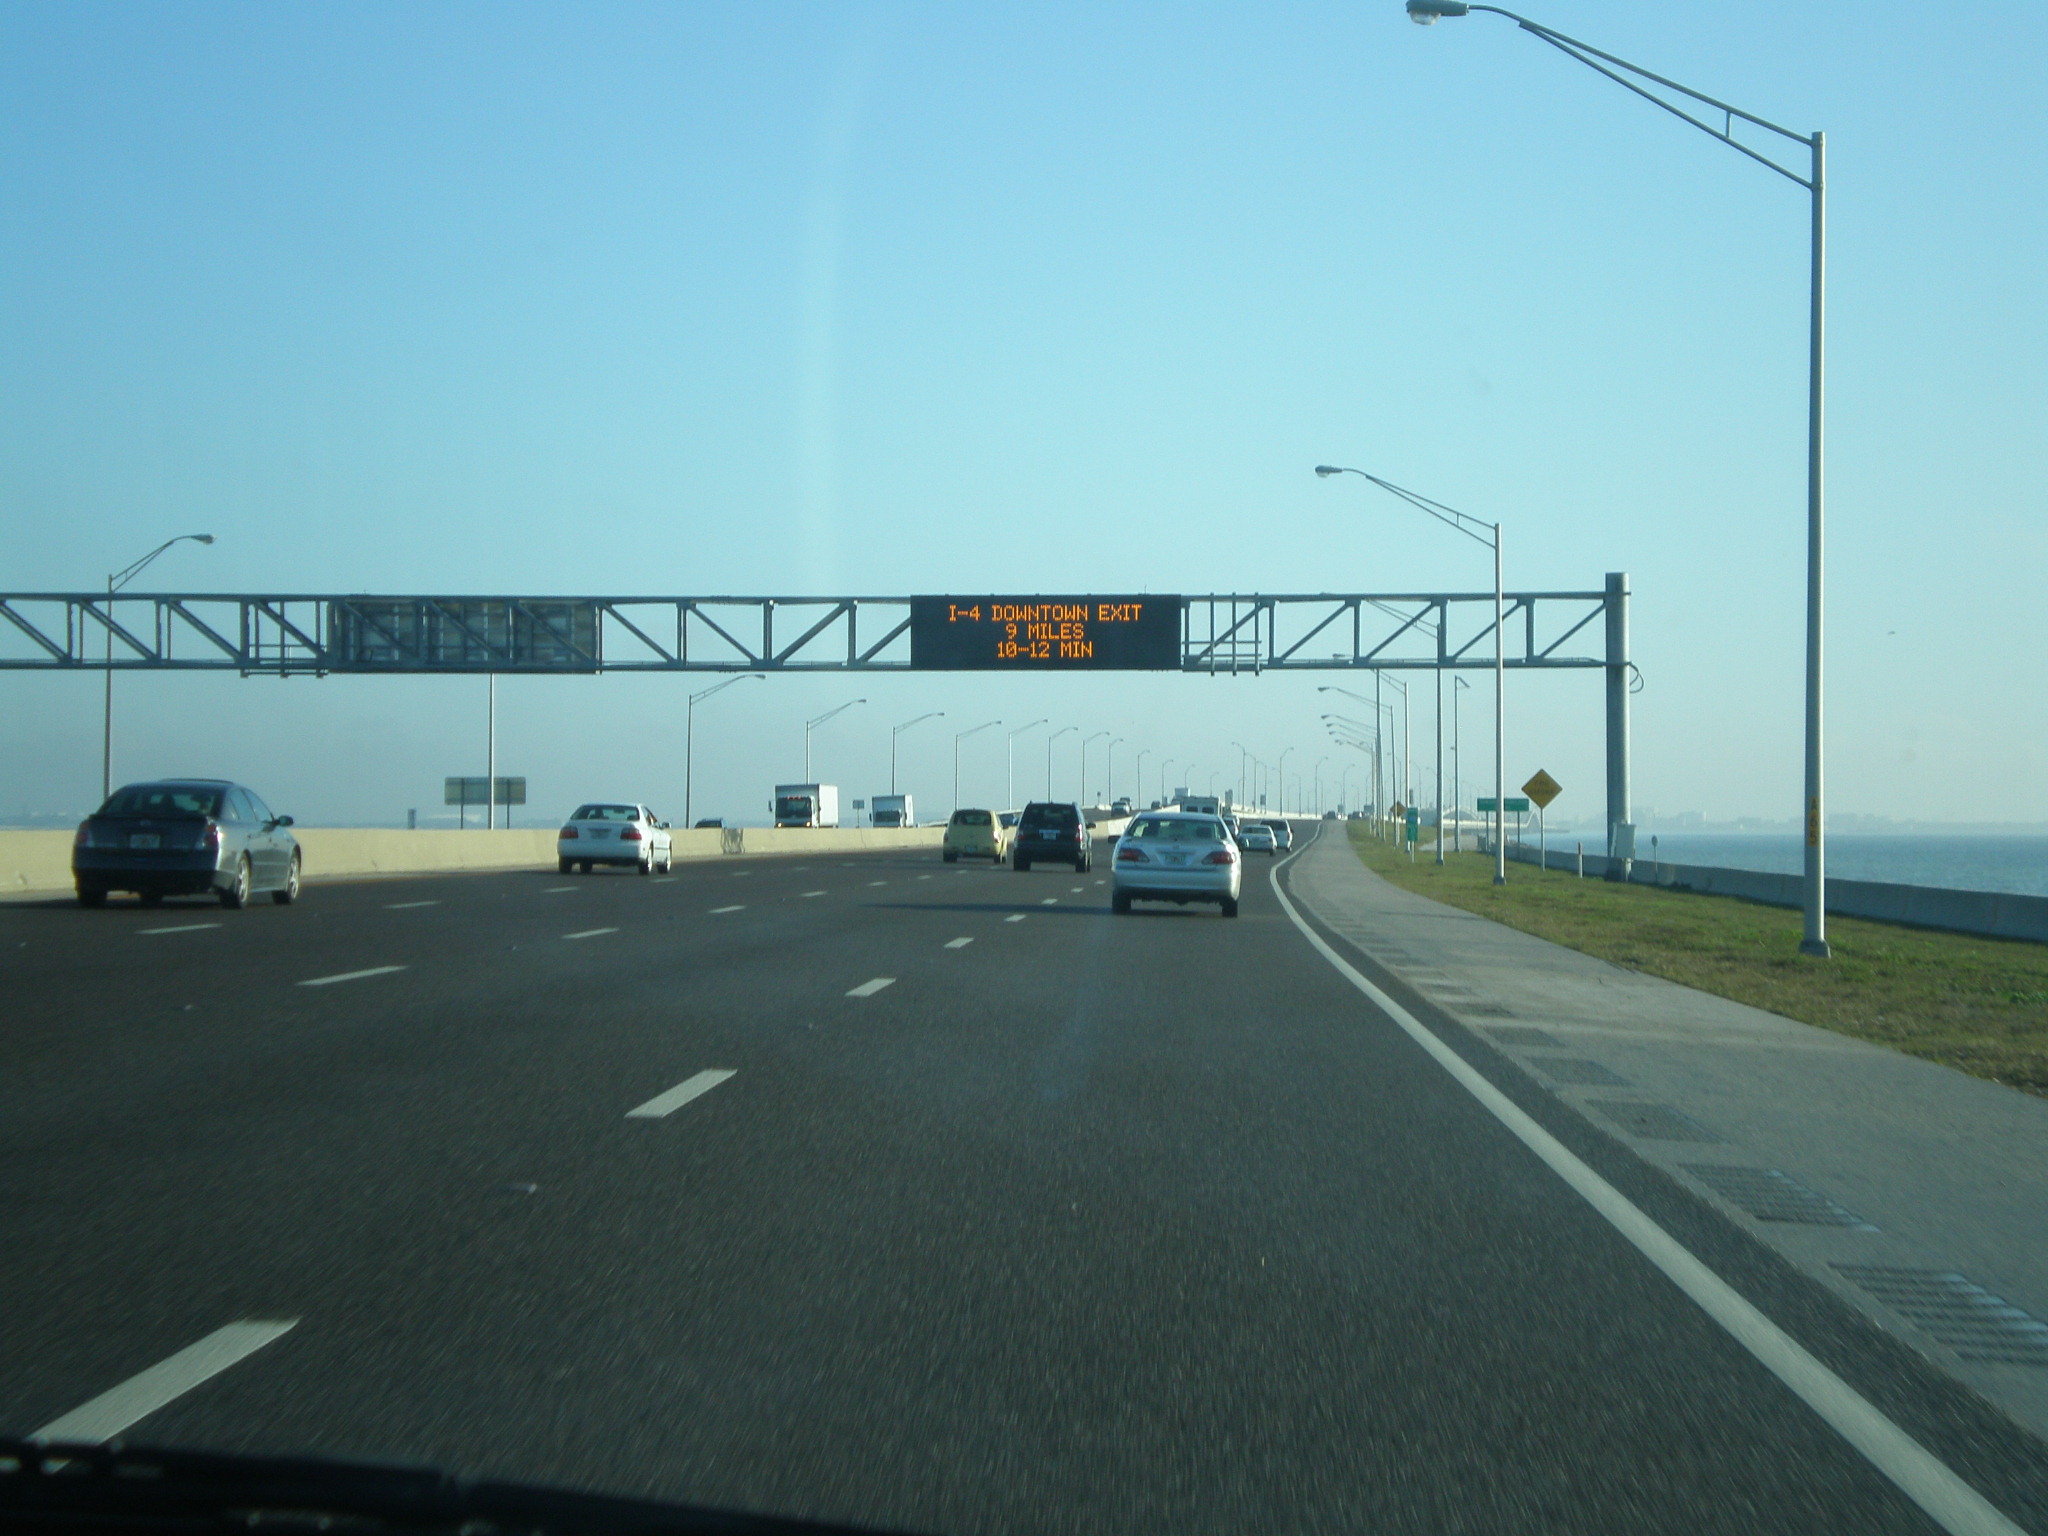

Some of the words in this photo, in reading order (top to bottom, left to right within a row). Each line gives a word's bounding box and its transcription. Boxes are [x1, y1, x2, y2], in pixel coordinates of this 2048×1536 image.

[949, 604, 981, 622] I-4
[991, 604, 1089, 622] DOWNTOWN
[1098, 604, 1143, 622] EXIT
[1006, 622, 1018, 640] 9
[1028, 622, 1085, 640] MILES
[997, 641, 1050, 659] 10-12
[1060, 641, 1093, 659] MIN
